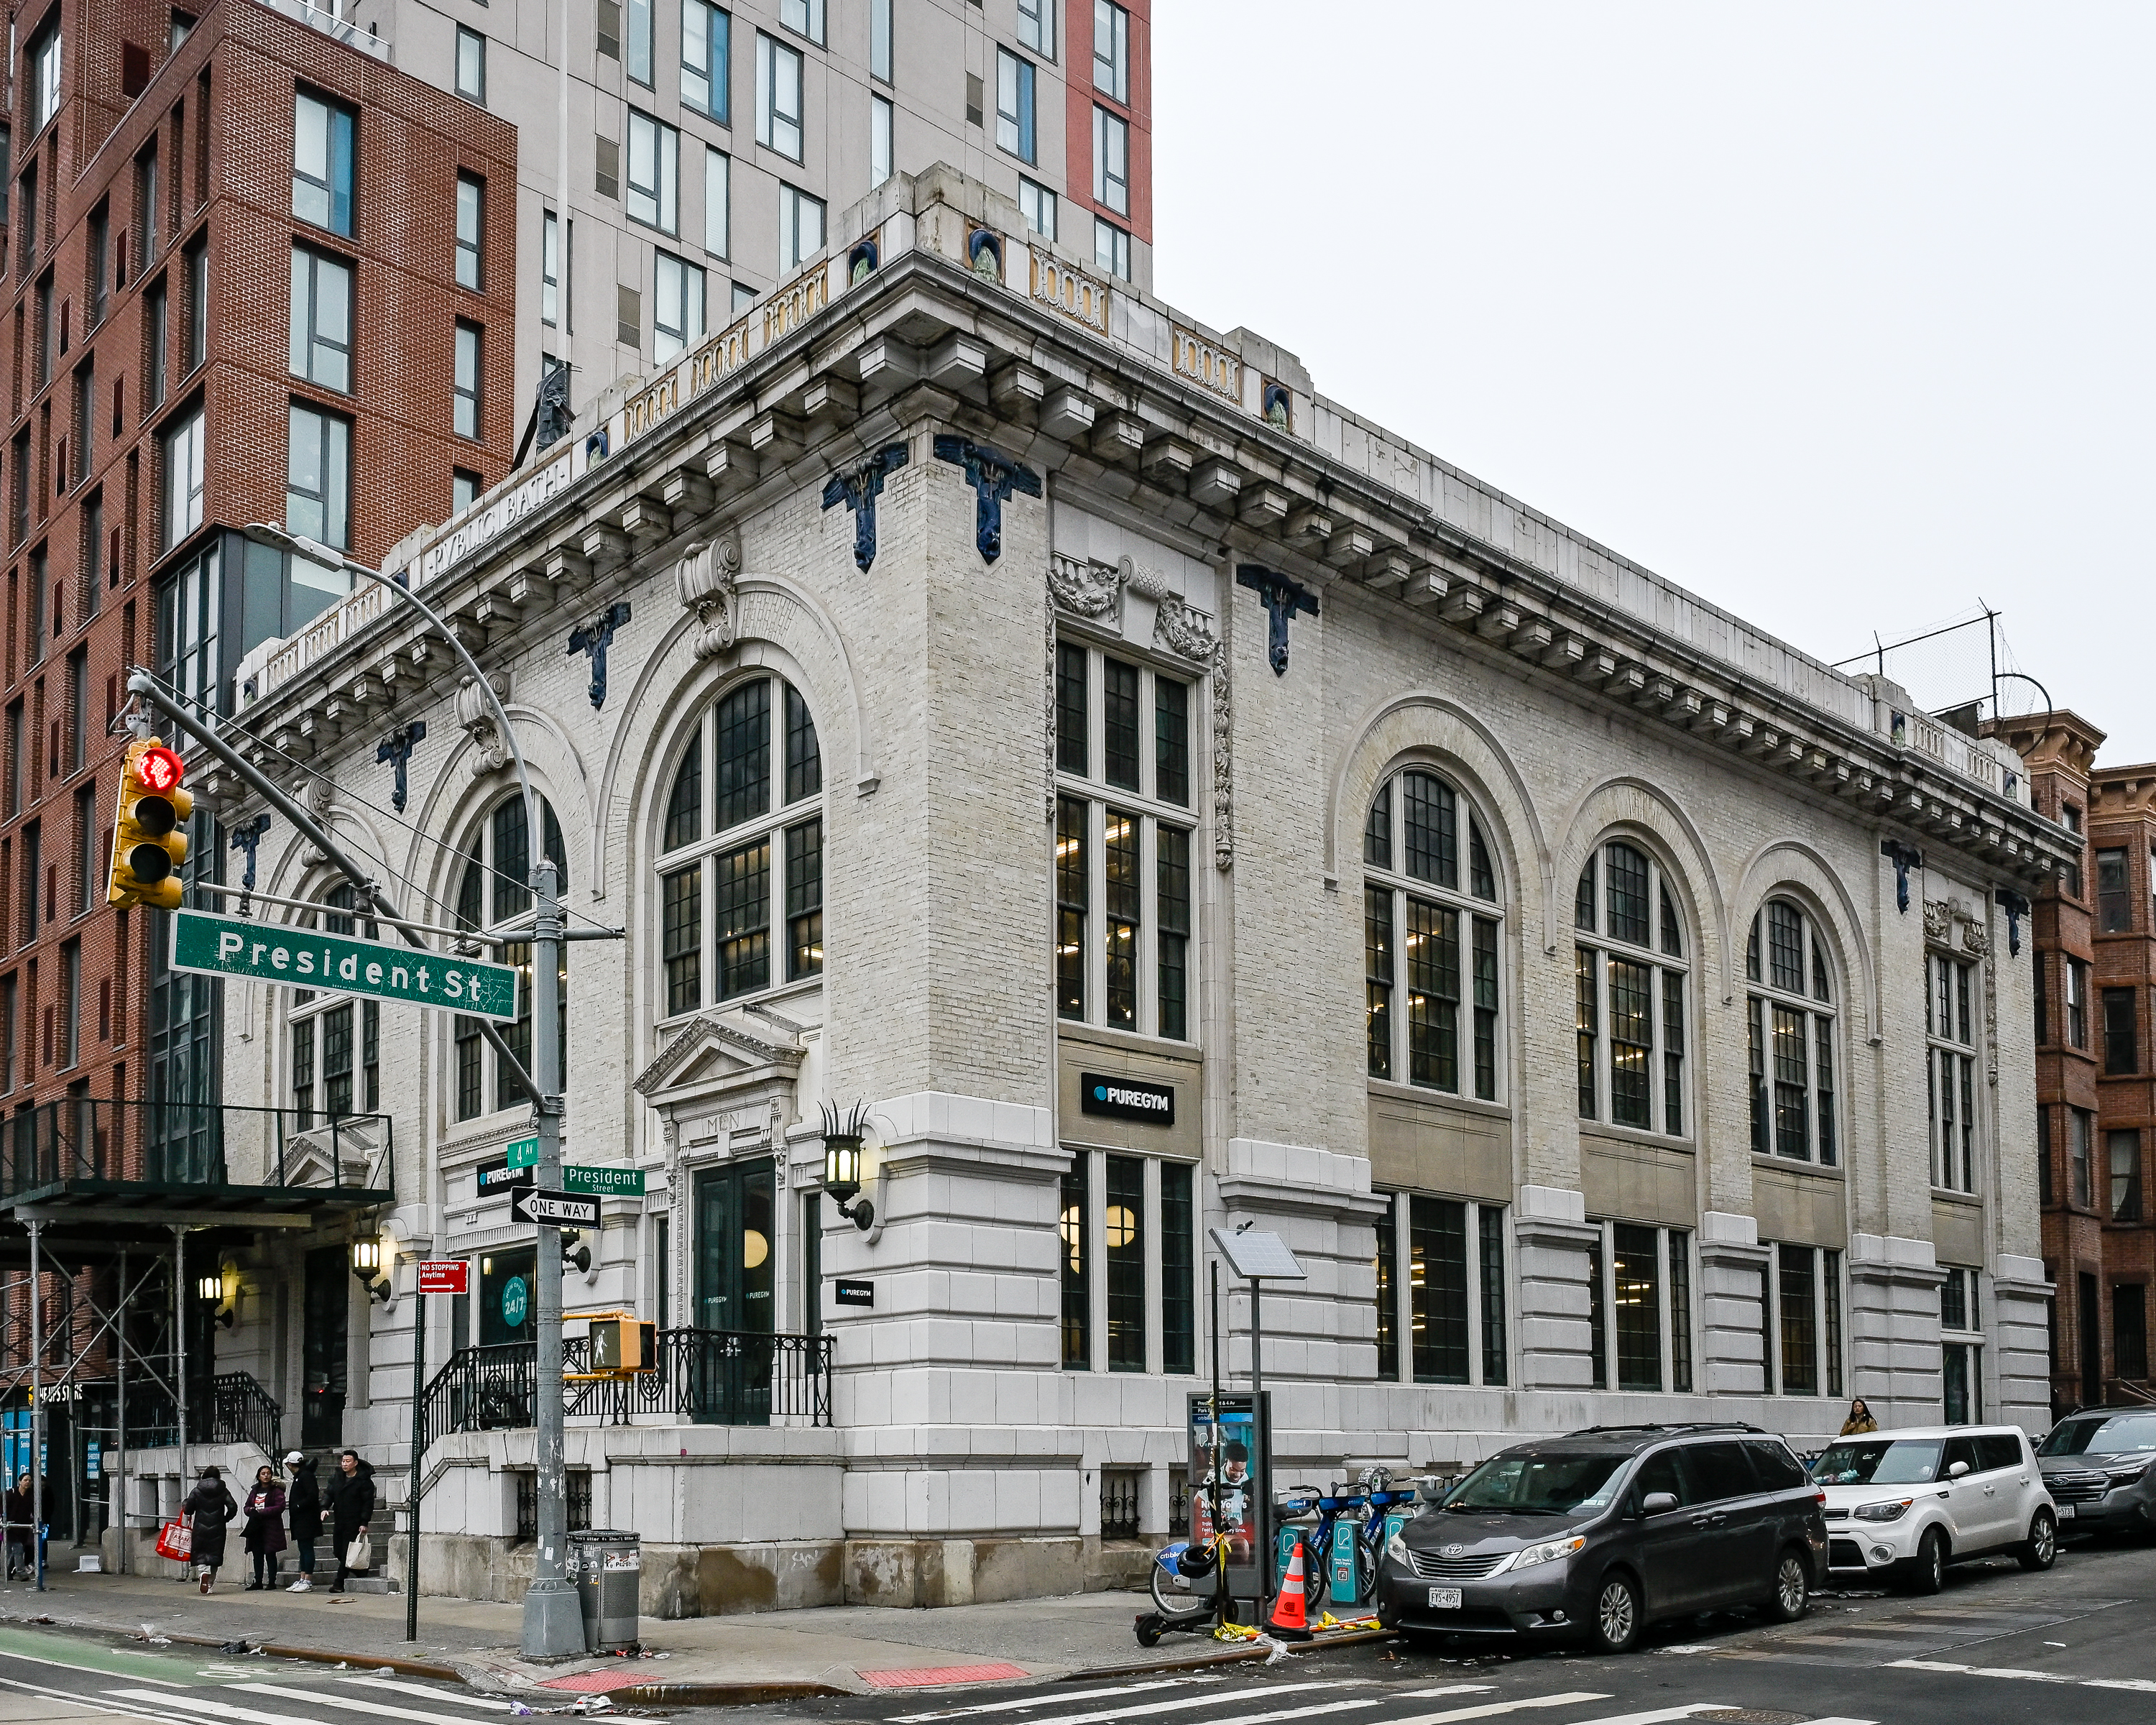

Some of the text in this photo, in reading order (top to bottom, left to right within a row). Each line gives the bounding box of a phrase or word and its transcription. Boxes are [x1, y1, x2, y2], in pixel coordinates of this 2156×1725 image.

[506, 464, 558, 526] BATH
[218, 931, 482, 1002] President St
[1107, 1087, 1169, 1111] PUREGYM
[707, 1113, 740, 1134] MEN
[516, 1143, 533, 1164] 4 Av
[569, 1168, 637, 1186] President
[592, 1184, 614, 1192] Street
[530, 1199, 589, 1218] ONE WAY
[421, 1271, 446, 1279] Anytime
[749, 1291, 770, 1300] PUREGYM
[846, 1289, 871, 1297] PUREGYM
[505, 1296, 524, 1315] 24/7
[62, 1384, 83, 1402] STRE
